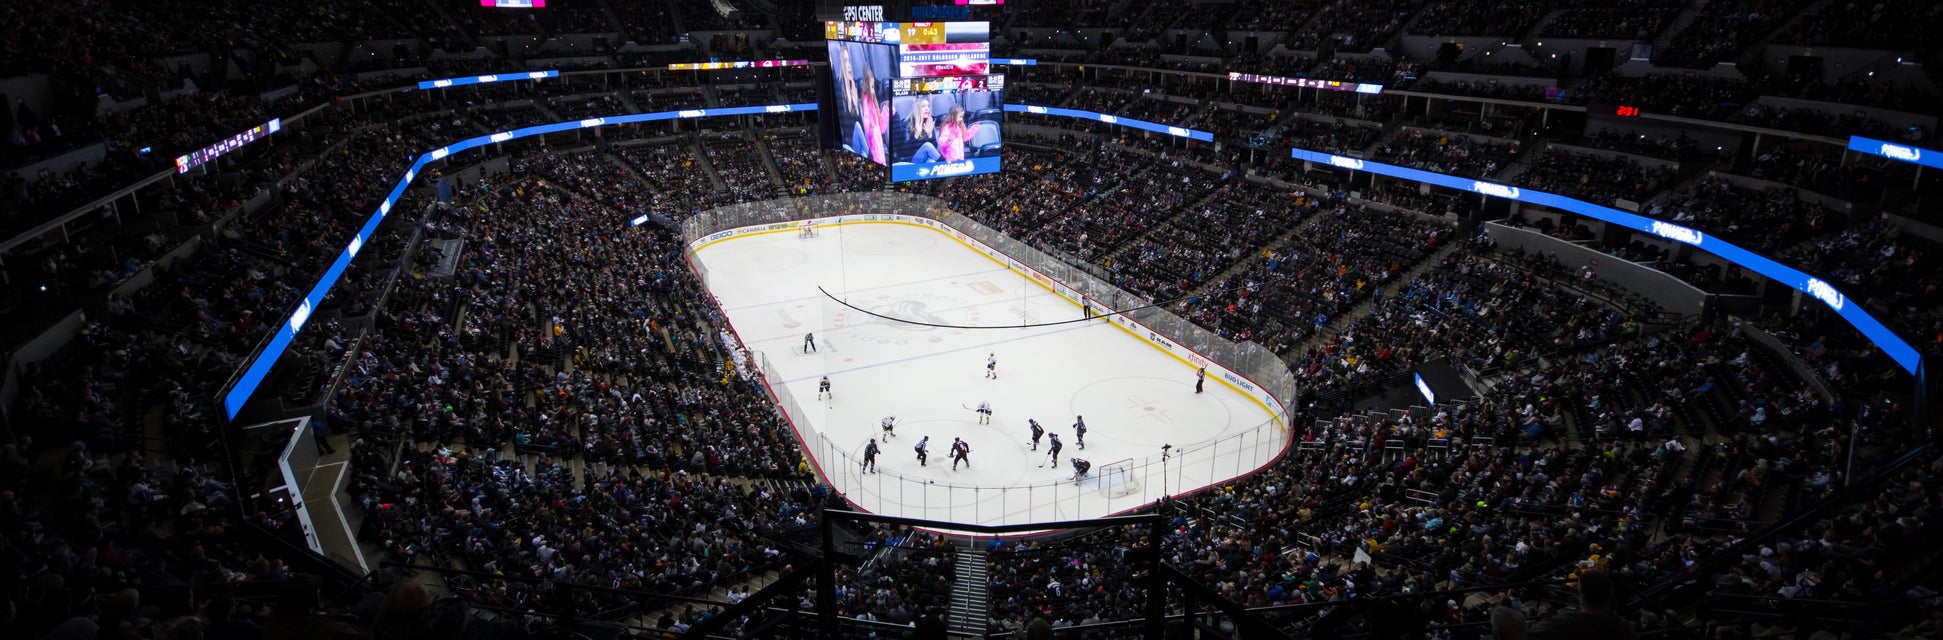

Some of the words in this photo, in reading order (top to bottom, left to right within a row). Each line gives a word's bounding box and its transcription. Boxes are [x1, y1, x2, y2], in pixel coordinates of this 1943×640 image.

[858, 6, 883, 21] CENTER
[907, 28, 916, 36] 19
[923, 28, 938, 36] 0:43
[978, 80, 984, 89] 2
[710, 230, 733, 241] GEICO
[742, 226, 766, 234] CAMBRIA
[1156, 337, 1172, 349] RAM
[1187, 353, 1209, 369] xfinity
[1224, 372, 1238, 384] BUD
[1237, 379, 1254, 392] LIGHT
